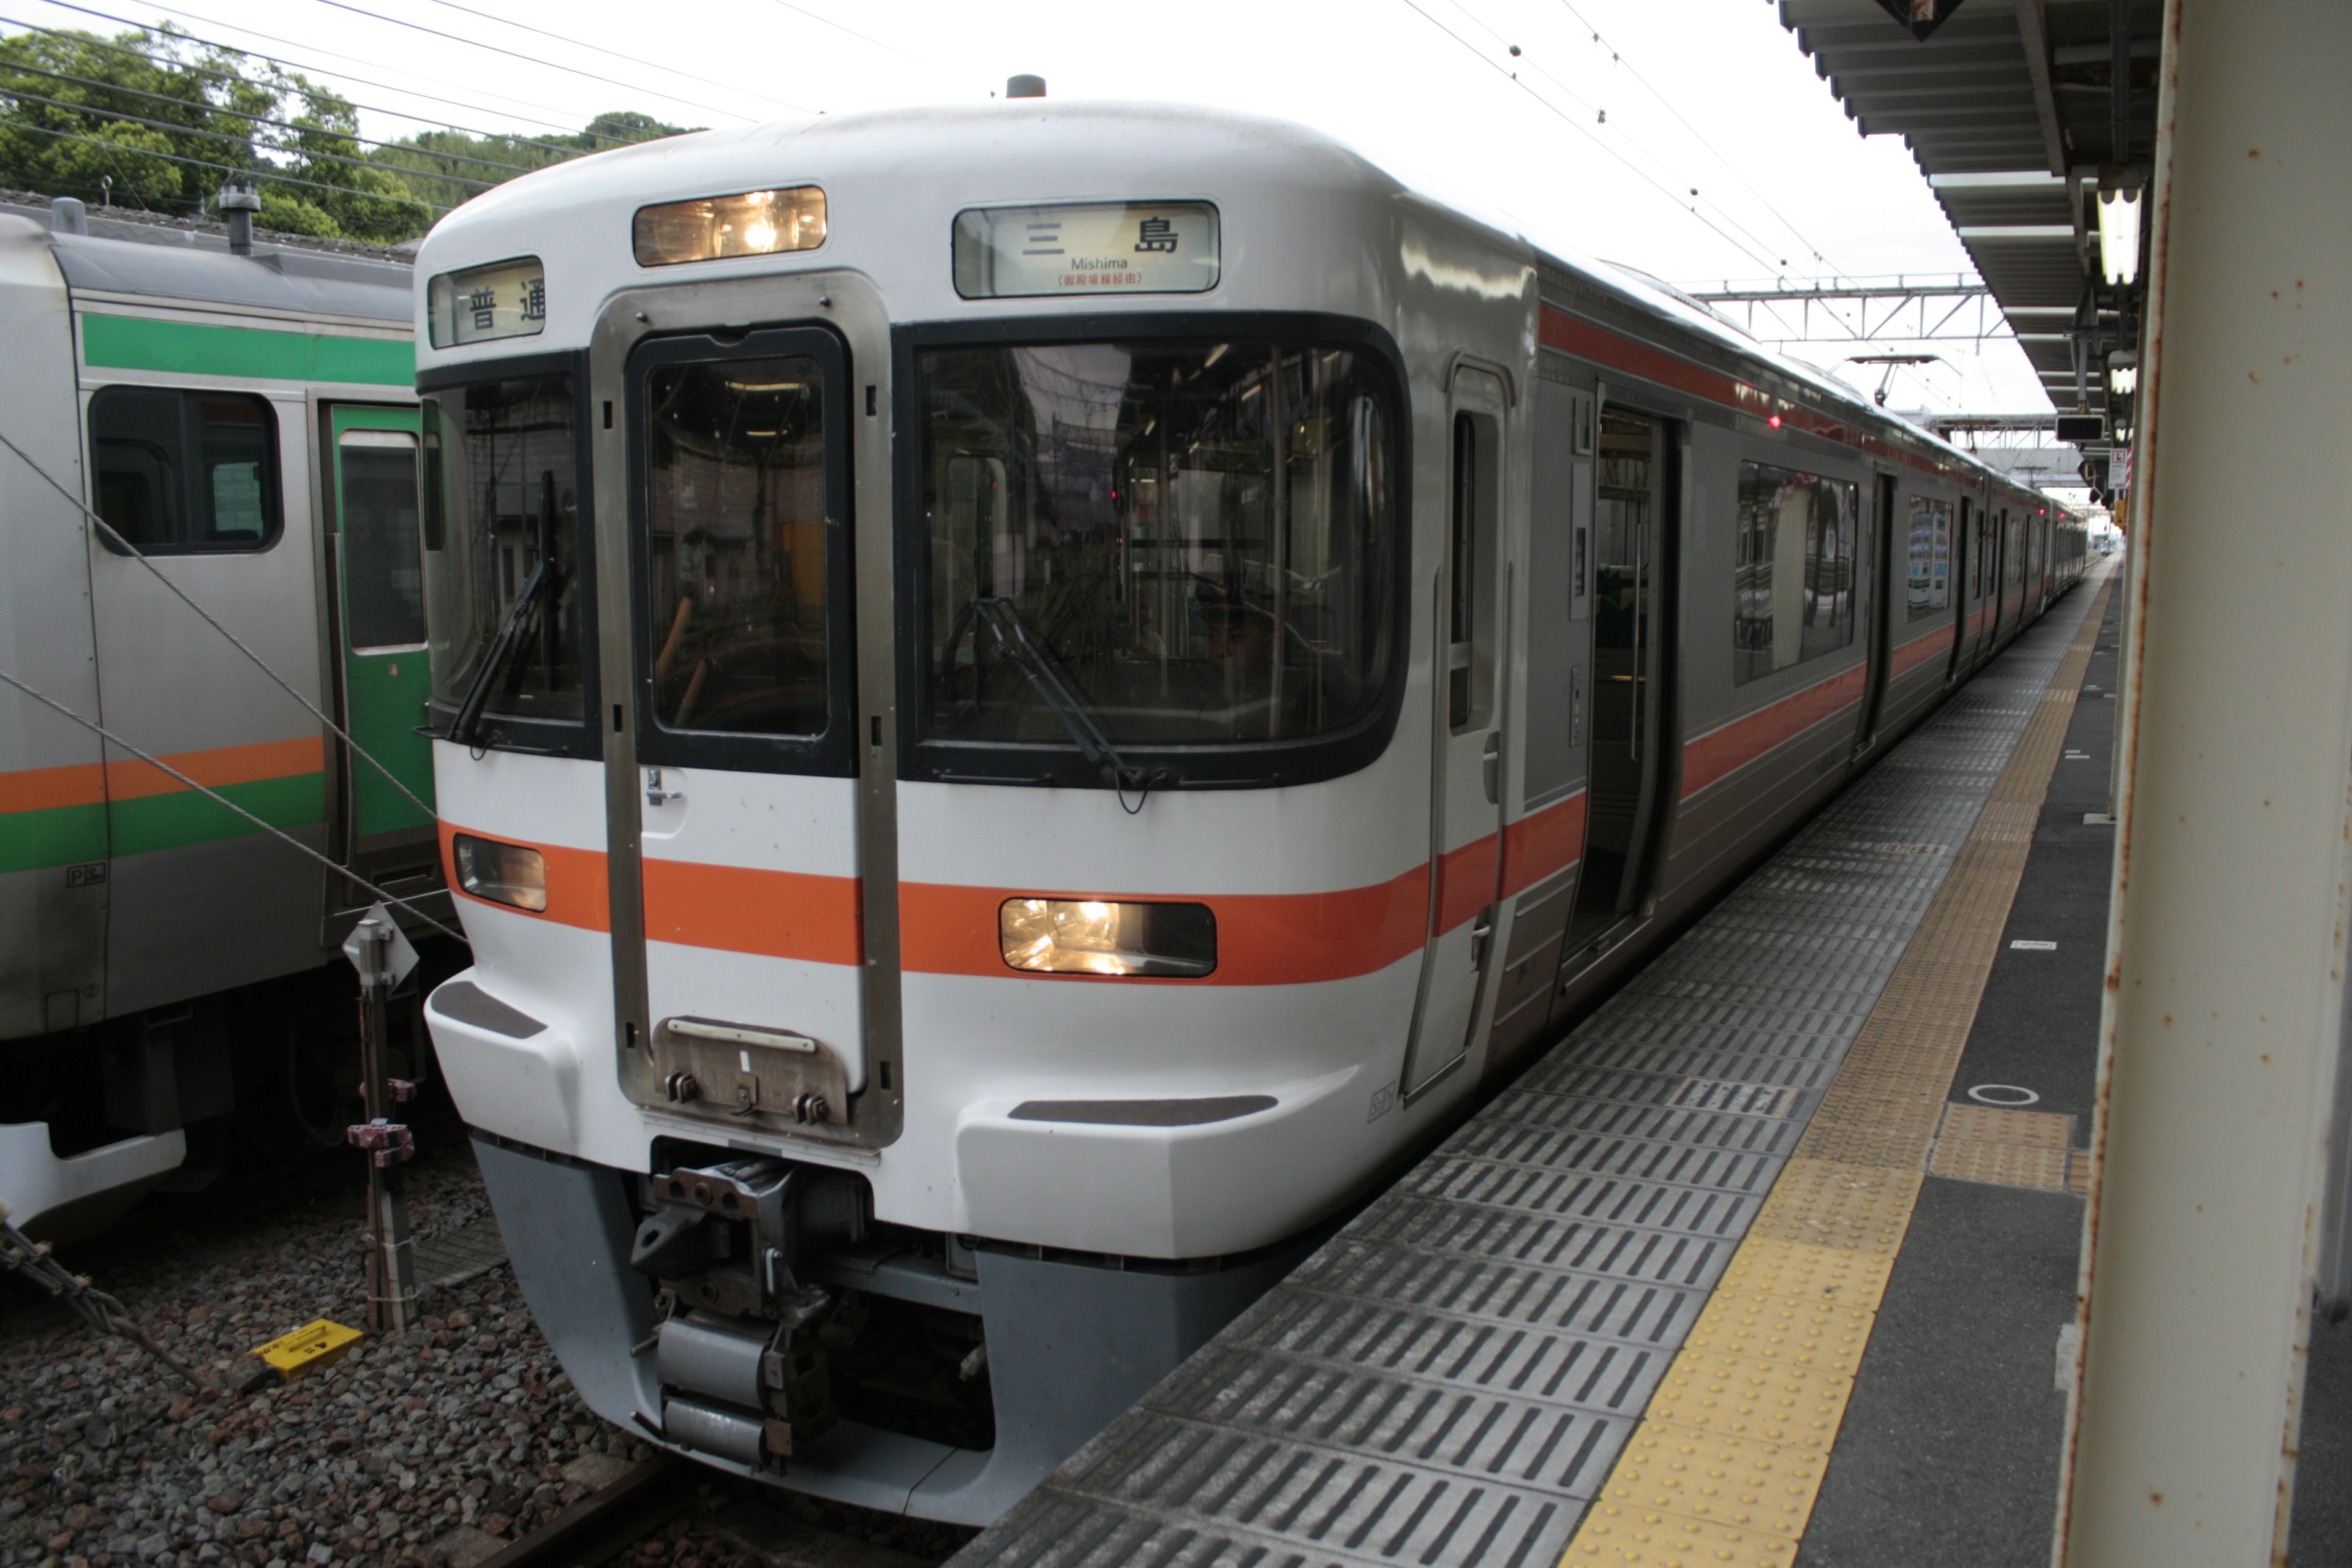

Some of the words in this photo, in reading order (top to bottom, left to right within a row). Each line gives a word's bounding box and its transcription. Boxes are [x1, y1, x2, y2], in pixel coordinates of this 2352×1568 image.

[1022, 217, 1179, 255] 三島
[1071, 258, 1128, 270] Mishima
[470, 278, 546, 330] 普通
